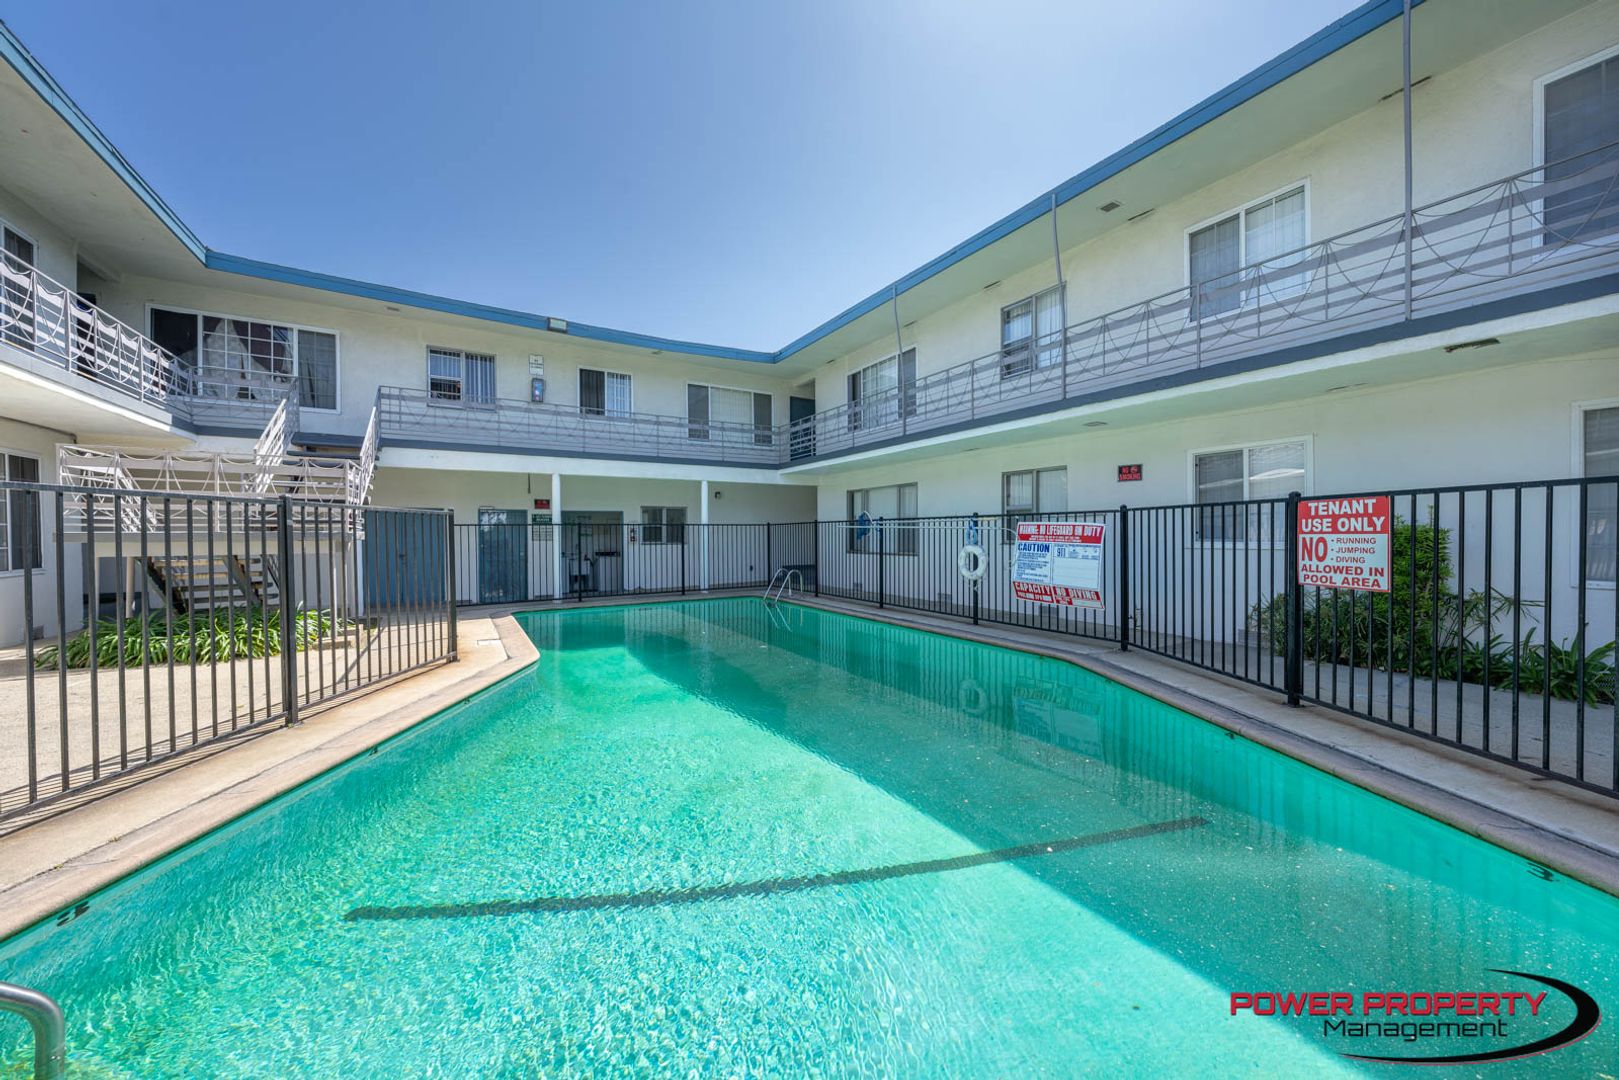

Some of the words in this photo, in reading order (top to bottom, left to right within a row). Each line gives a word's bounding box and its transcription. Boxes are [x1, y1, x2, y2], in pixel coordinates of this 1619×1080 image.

[1308, 498, 1376, 516] TENANT
[1301, 518, 1332, 532] USE
[1337, 516, 1385, 532] ONLY
[1083, 526, 1102, 537] DUTY
[1336, 537, 1376, 545] RUNNING
[1018, 543, 1050, 553] CAUTION
[1057, 547, 1066, 558] 911
[1301, 536, 1328, 563] NO
[1336, 546, 1376, 554] JUMPING
[1336, 556, 1366, 564] DIVING
[1301, 563, 1364, 576] ALLOWED
[1368, 567, 1384, 577] IN
[1303, 574, 1337, 585] POOL
[1341, 576, 1381, 588] AREA
[1015, 582, 1051, 594] CAPACITY
[1069, 588, 1097, 601] DIVING
